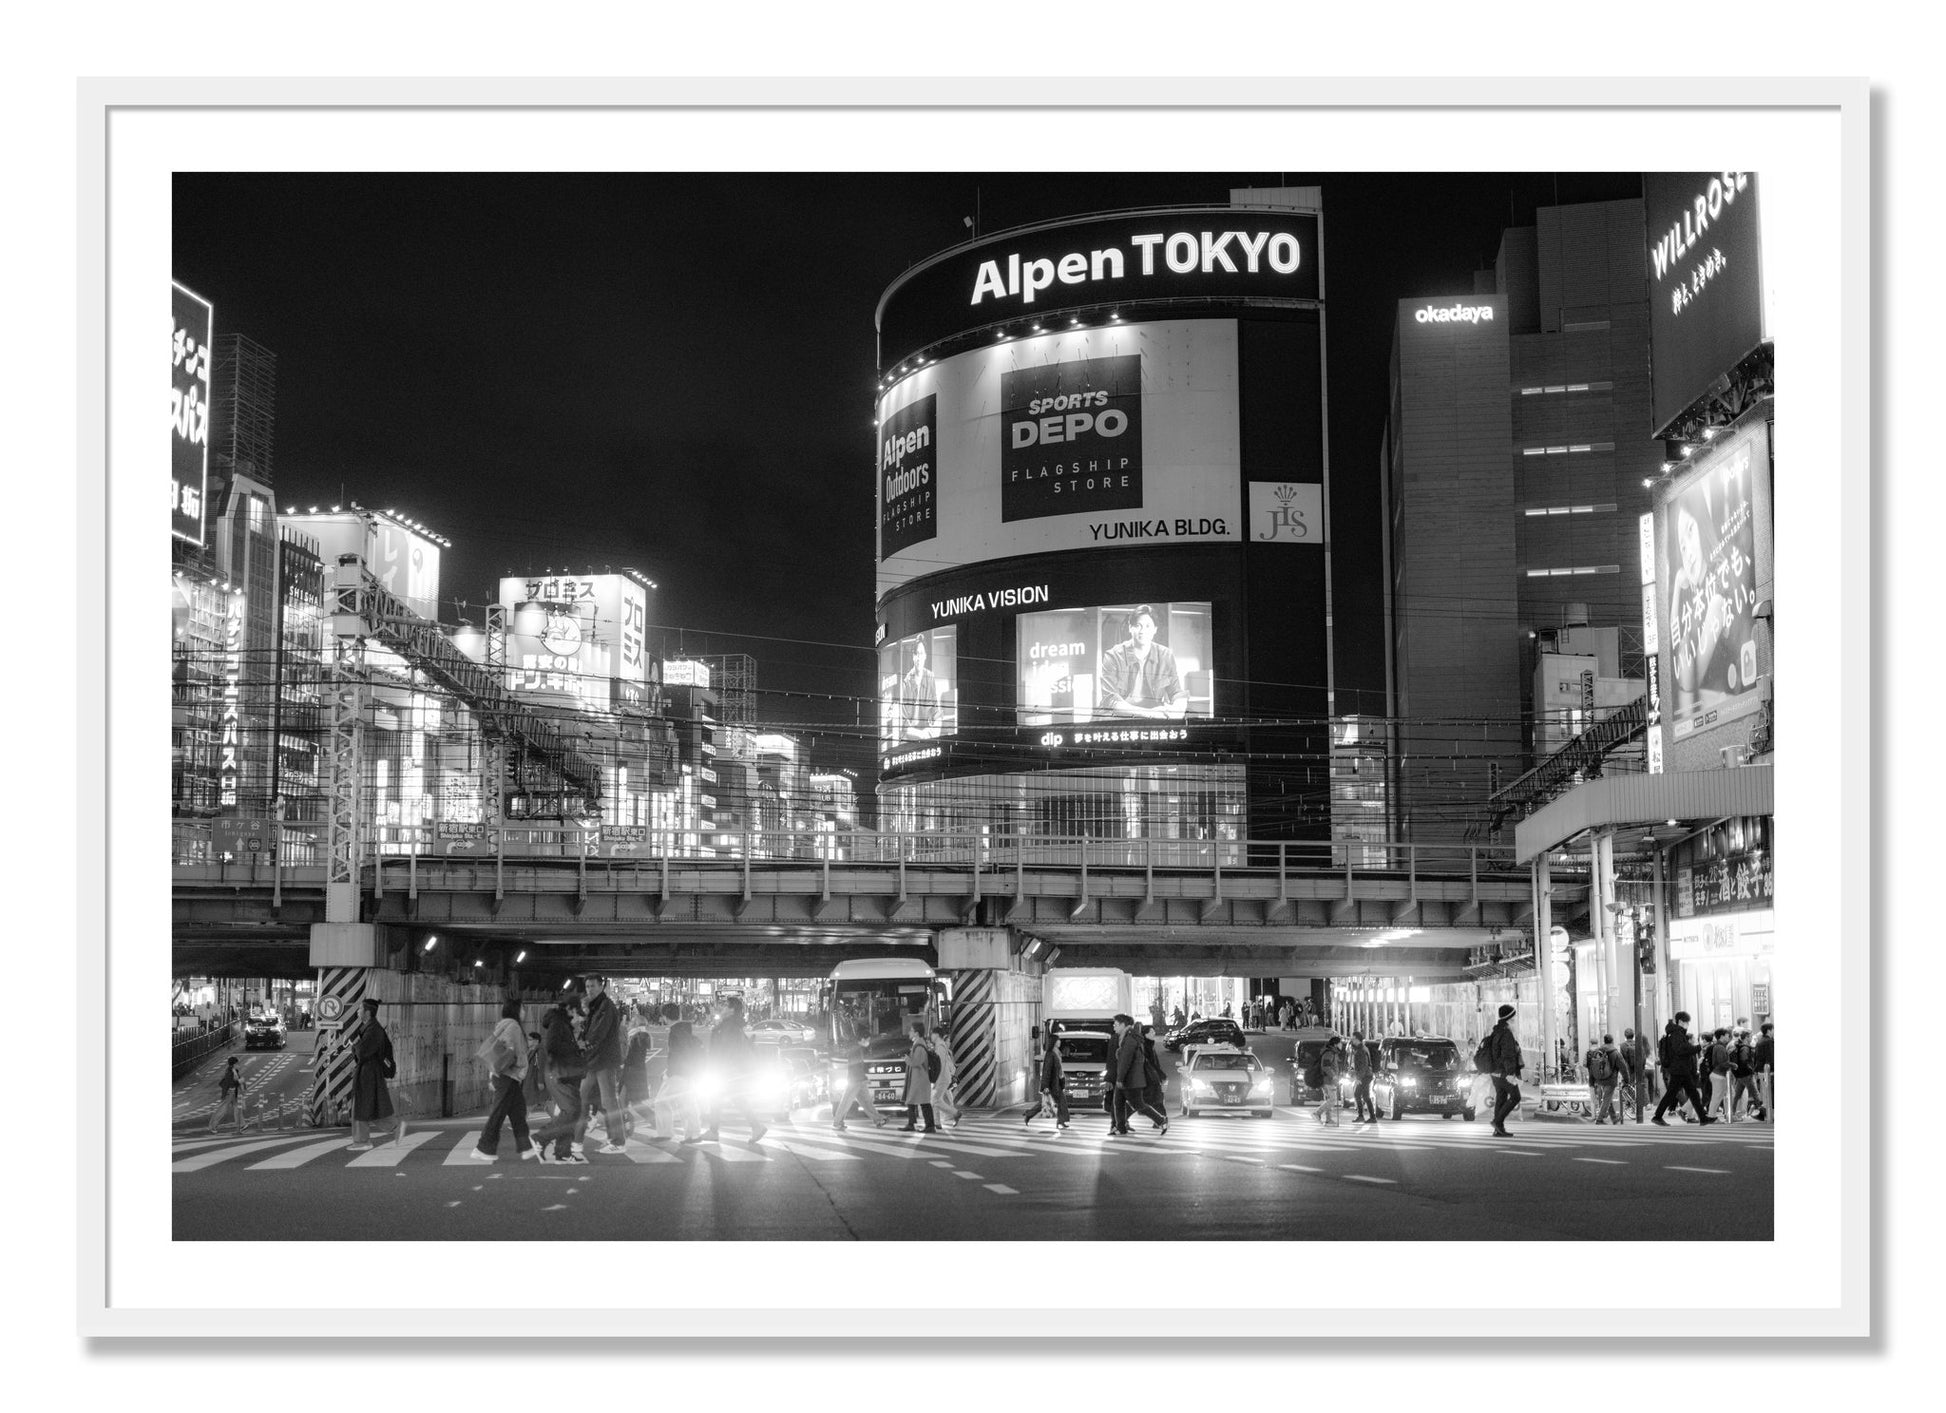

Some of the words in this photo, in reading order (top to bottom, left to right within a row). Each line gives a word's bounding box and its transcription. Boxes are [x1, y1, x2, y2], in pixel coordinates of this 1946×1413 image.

[970, 245, 1125, 305] Alpen
[1131, 231, 1301, 276] TOKYO
[1415, 304, 1493, 324] okadaya
[1028, 390, 1109, 416] SPORTS
[1012, 408, 1129, 449] DEPO
[883, 424, 930, 470] Alpen
[1012, 457, 1130, 482] FLAGSHIP
[885, 462, 930, 504] Outdoors
[1054, 475, 1130, 494] STORE
[883, 490, 931, 525] FLAGSHIP
[896, 507, 931, 532] STORE
[1089, 519, 1170, 541] YUNIKA
[1174, 517, 1231, 537] BLDG.
[525, 580, 596, 600] プロミス
[931, 593, 986, 620] YUNIKA
[988, 584, 1049, 610] VISION
[1029, 641, 1086, 659] dream
[1040, 731, 1063, 748] dip
